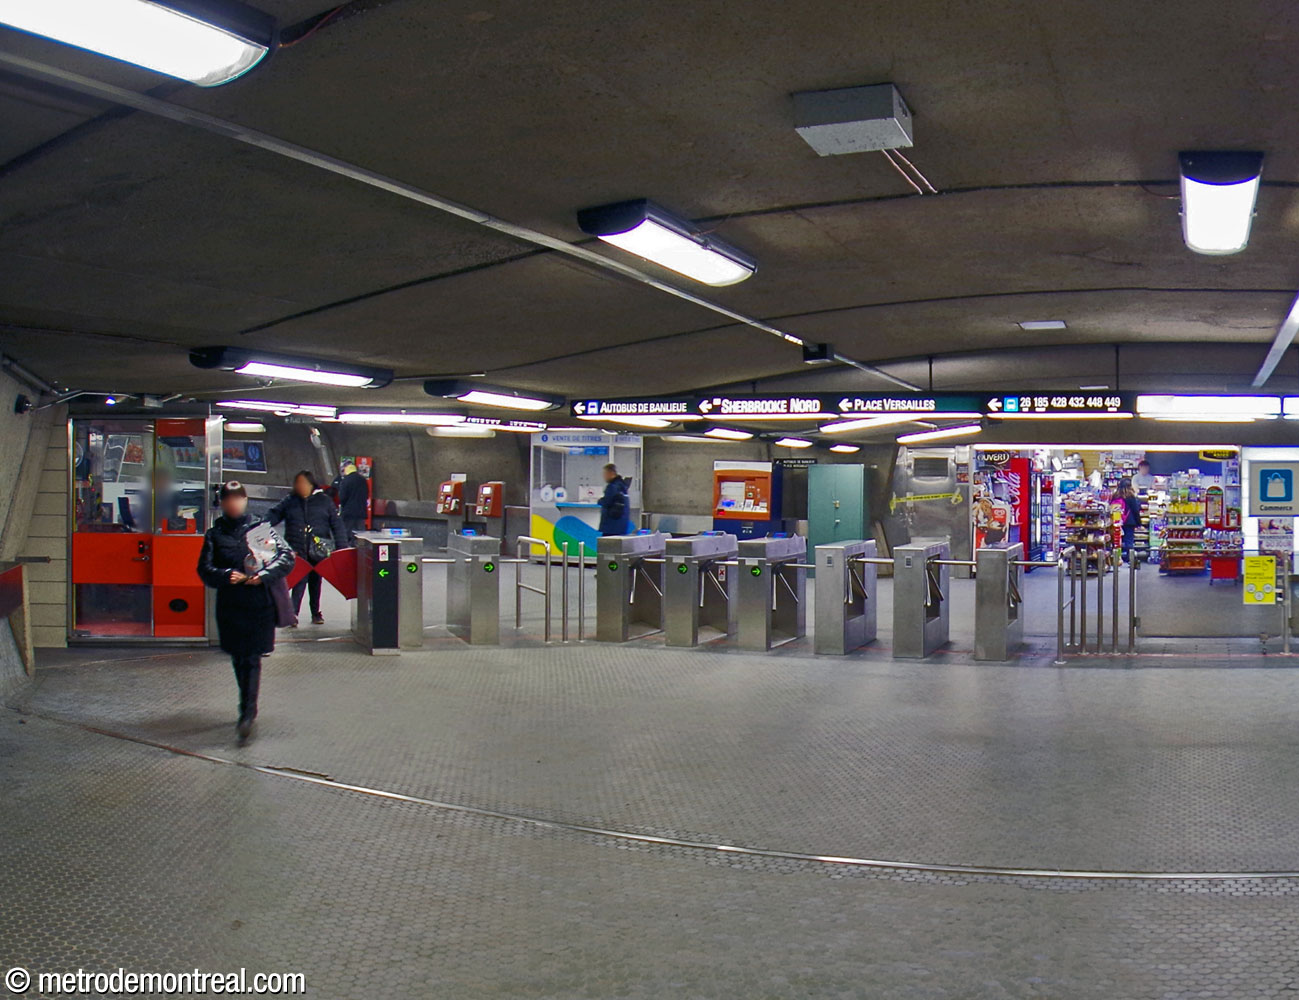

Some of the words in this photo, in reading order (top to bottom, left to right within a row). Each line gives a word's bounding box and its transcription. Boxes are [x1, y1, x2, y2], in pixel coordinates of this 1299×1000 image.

[600, 402, 637, 413] AUTOBUS
[638, 403, 648, 413] DE
[650, 402, 687, 413] BANLIEUE
[721, 398, 788, 413] SHERBROOKE
[790, 398, 821, 413] NORD
[854, 398, 883, 411] PLACE
[884, 398, 936, 411] VERSAILLES
[1020, 396, 1031, 408] 26
[1033, 396, 1049, 408] 185
[1050, 396, 1067, 408] 428
[1068, 396, 1085, 408] 432
[1086, 396, 1103, 408] 448
[1104, 396, 1121, 408] 449
